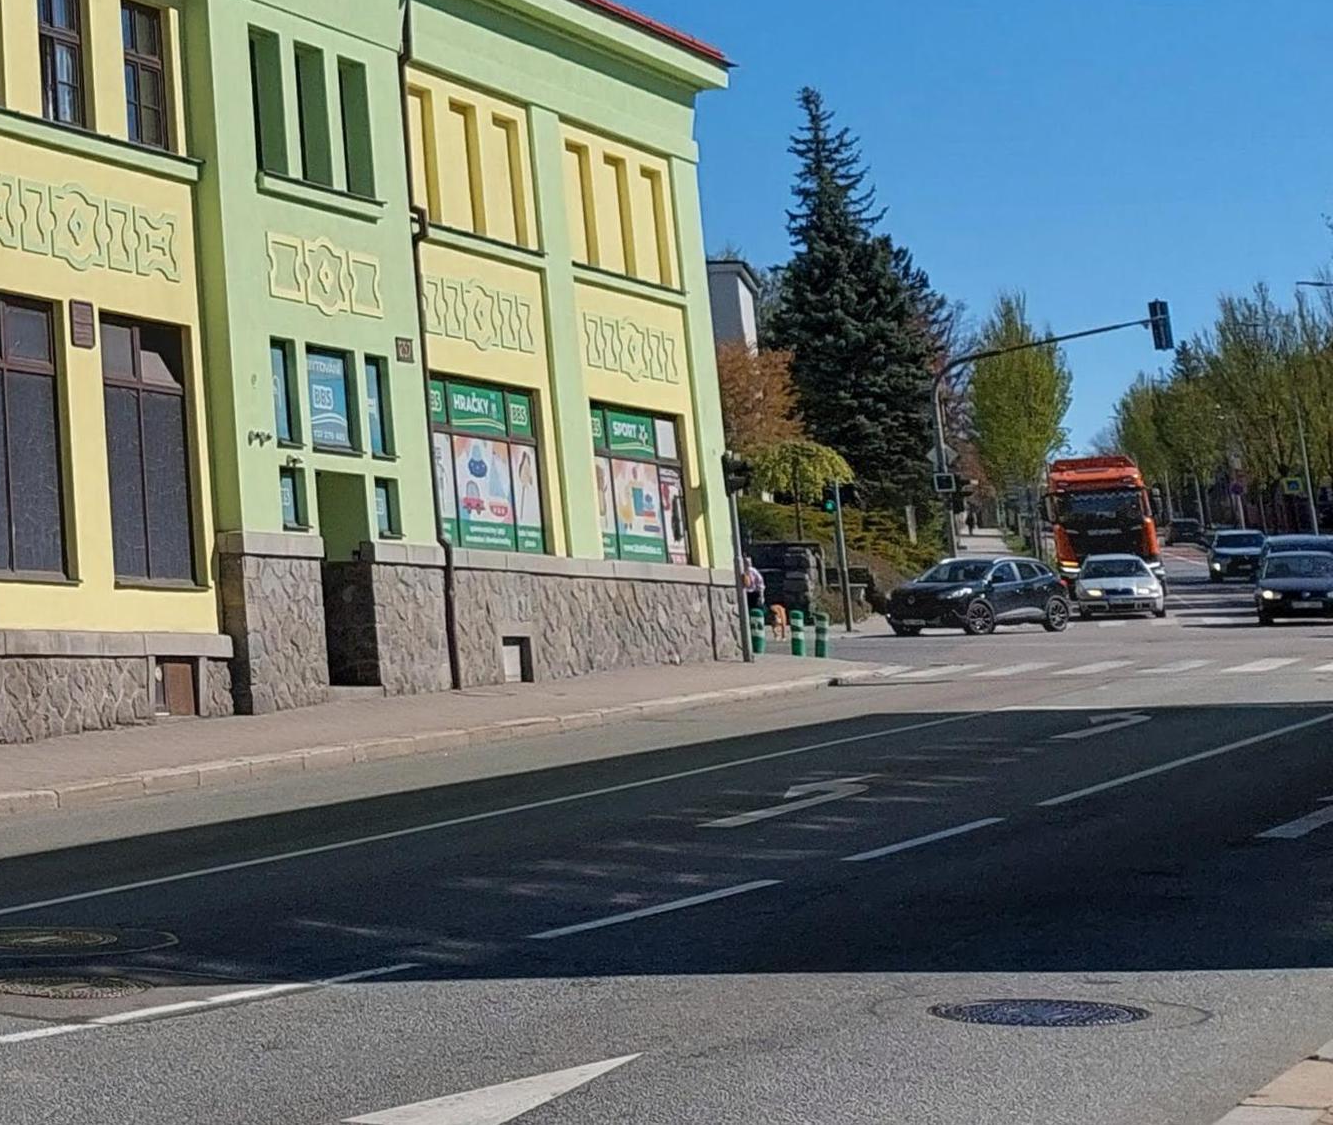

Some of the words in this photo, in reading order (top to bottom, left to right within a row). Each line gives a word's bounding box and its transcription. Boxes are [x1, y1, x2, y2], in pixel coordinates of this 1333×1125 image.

[314, 388, 332, 407] BBS
[453, 392, 489, 415] HRAČKY
[613, 421, 637, 439] SPORT
